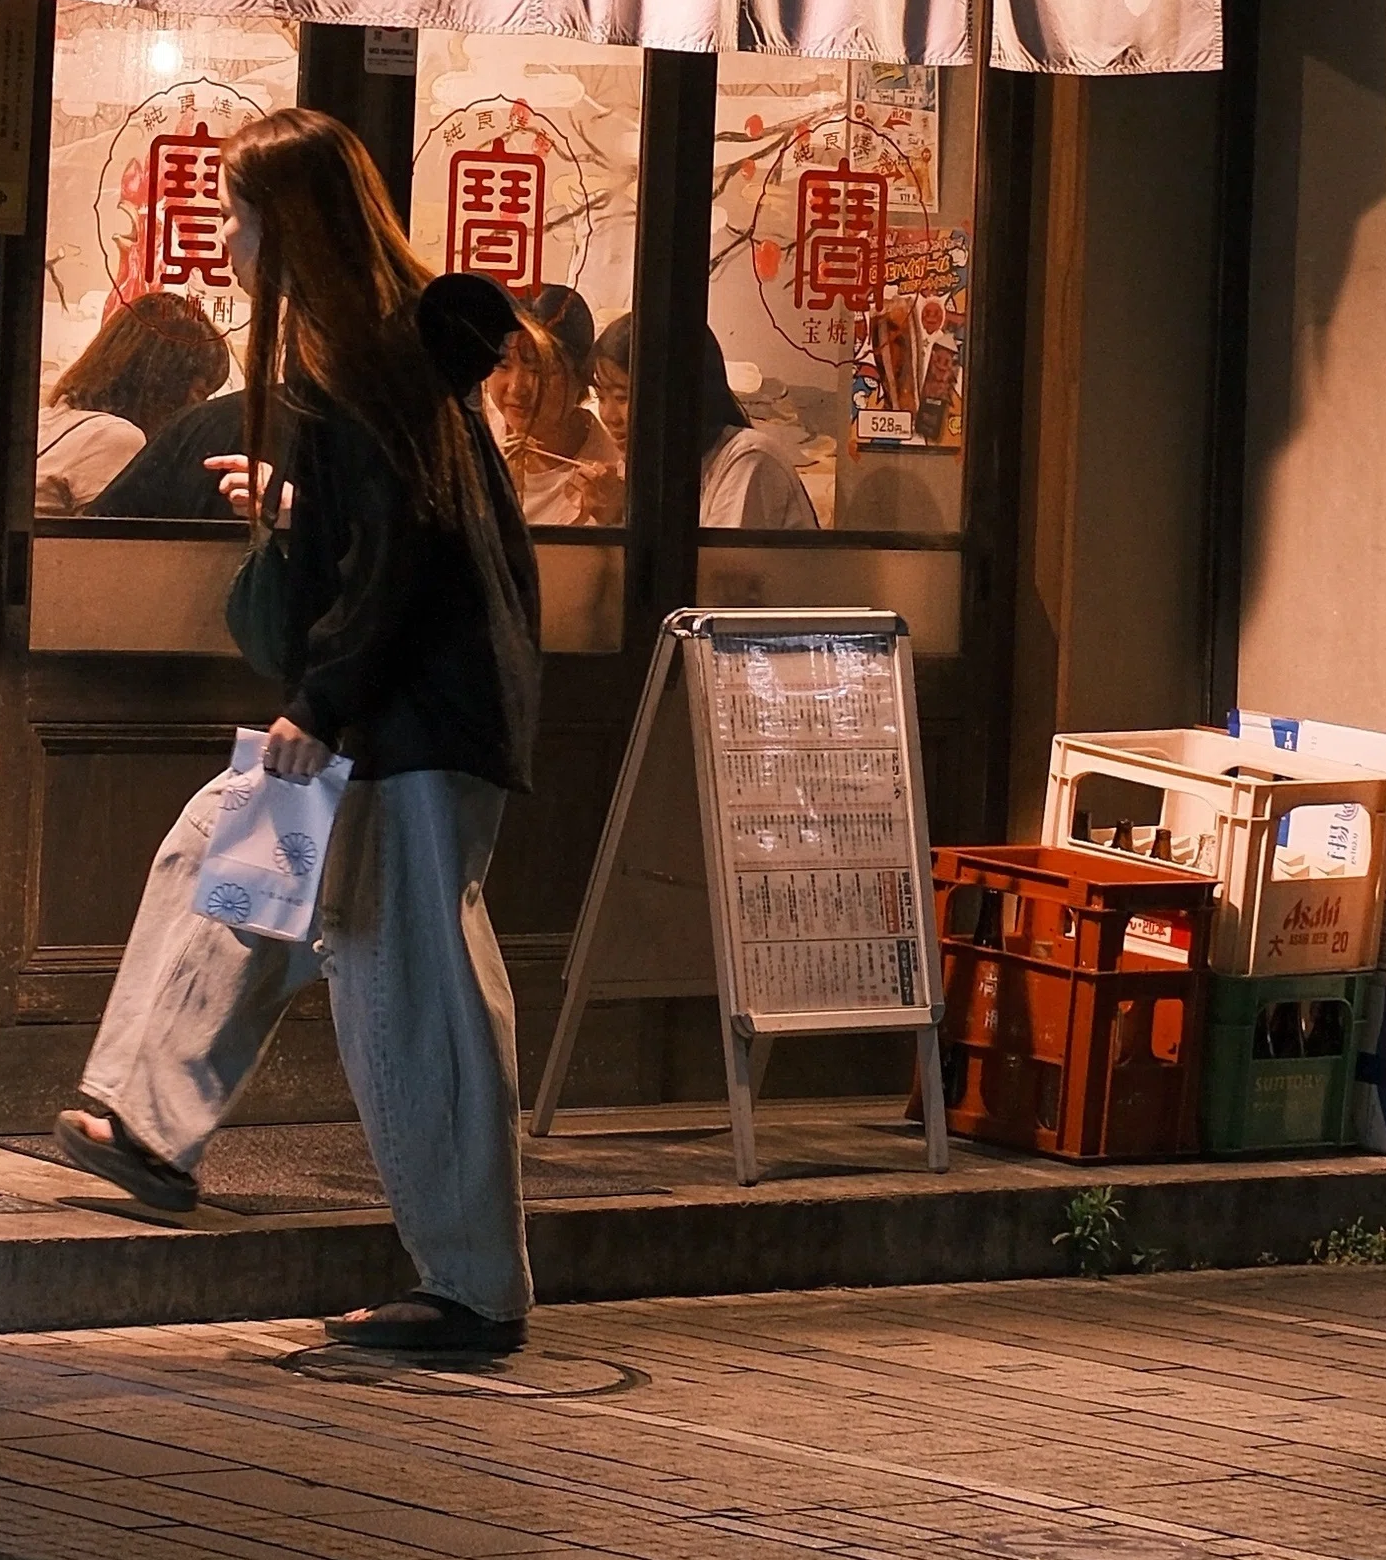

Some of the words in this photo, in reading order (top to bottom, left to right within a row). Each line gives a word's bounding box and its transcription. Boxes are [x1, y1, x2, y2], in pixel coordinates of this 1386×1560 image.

[1282, 895, 1342, 931] Asahi
[1268, 934, 1285, 957] 大
[1331, 931, 1349, 954] 20
